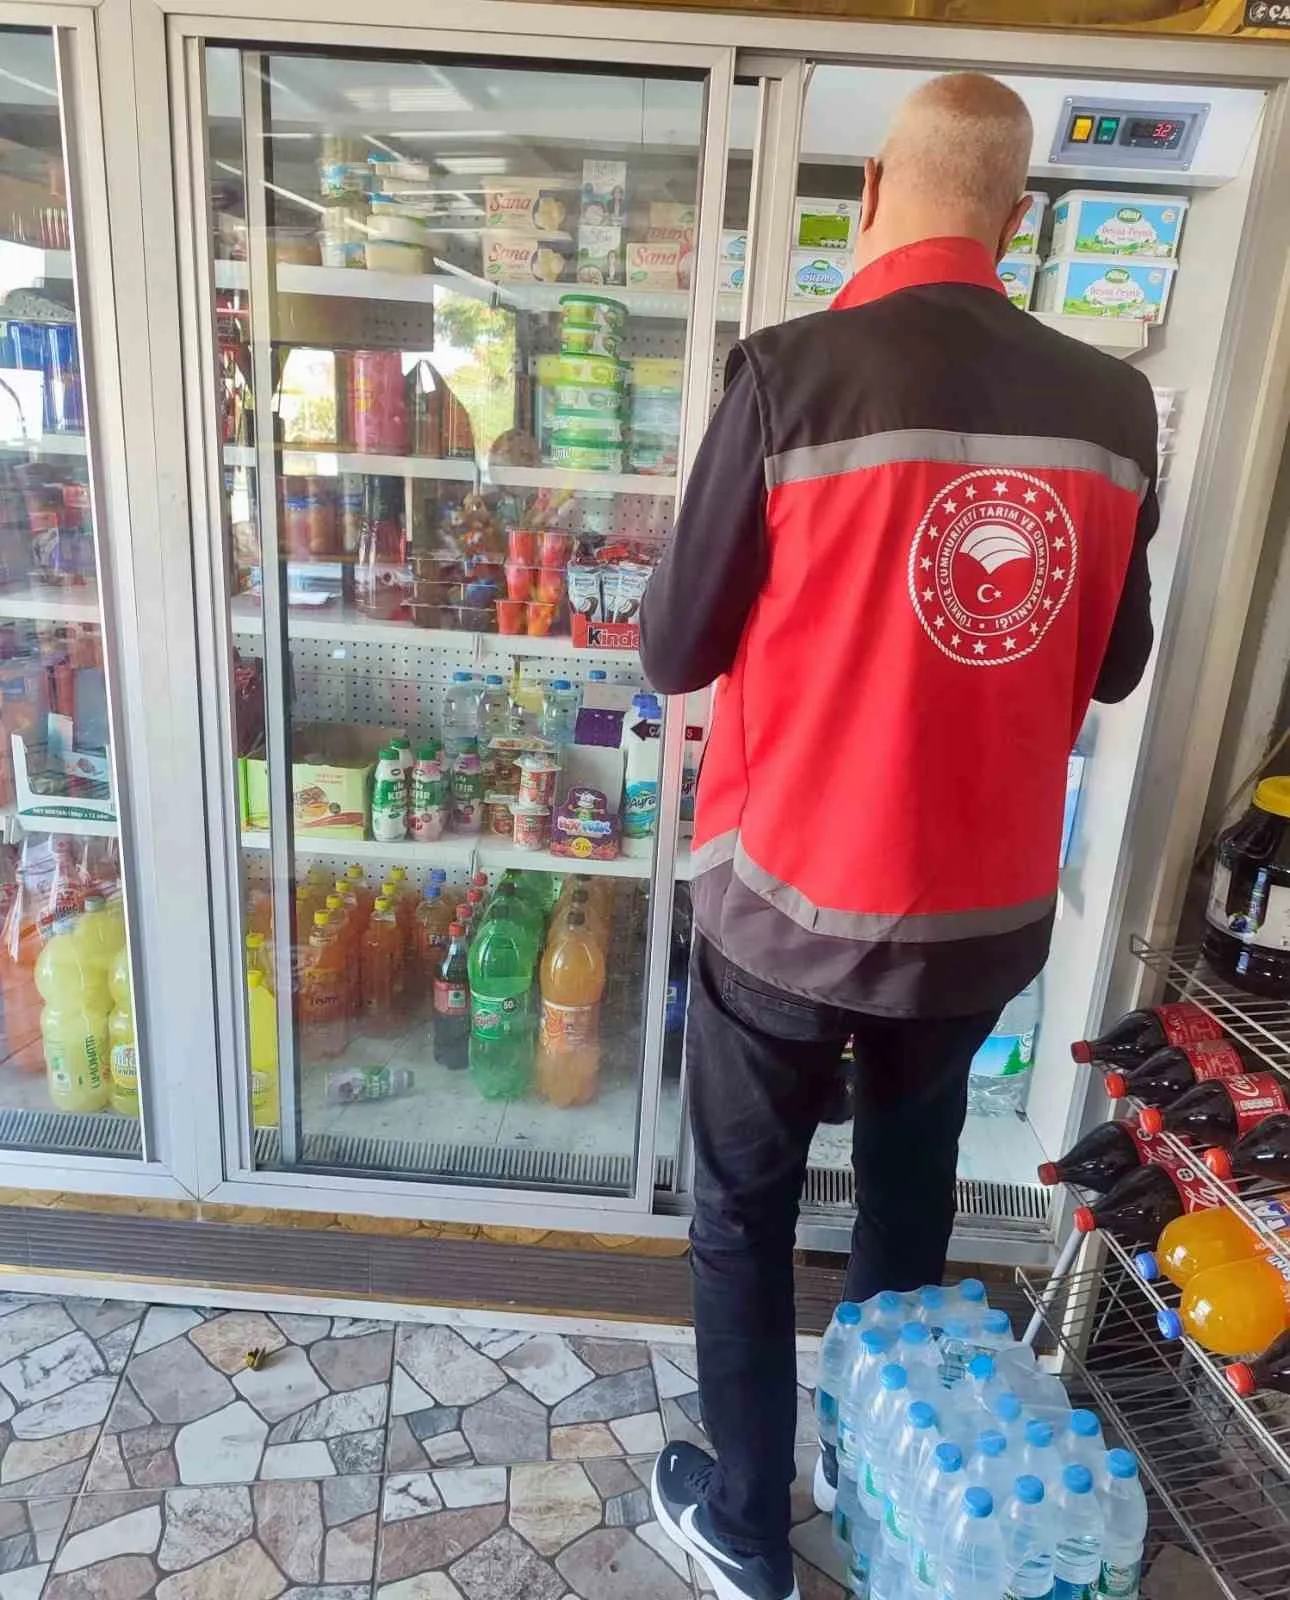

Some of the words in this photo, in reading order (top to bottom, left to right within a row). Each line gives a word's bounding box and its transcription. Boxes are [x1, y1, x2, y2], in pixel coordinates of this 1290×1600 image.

[489, 192, 532, 212] Sana
[488, 240, 530, 262] Sana
[632, 245, 677, 267] Sana
[979, 506, 1019, 520] TARIM
[1022, 515, 1036, 531] VE
[939, 509, 977, 585] CUMHURİYETİ
[1033, 530, 1044, 576] ORMAN
[943, 589, 972, 628] TÜRKİYE
[995, 578, 1044, 629] BAKANLIĞI
